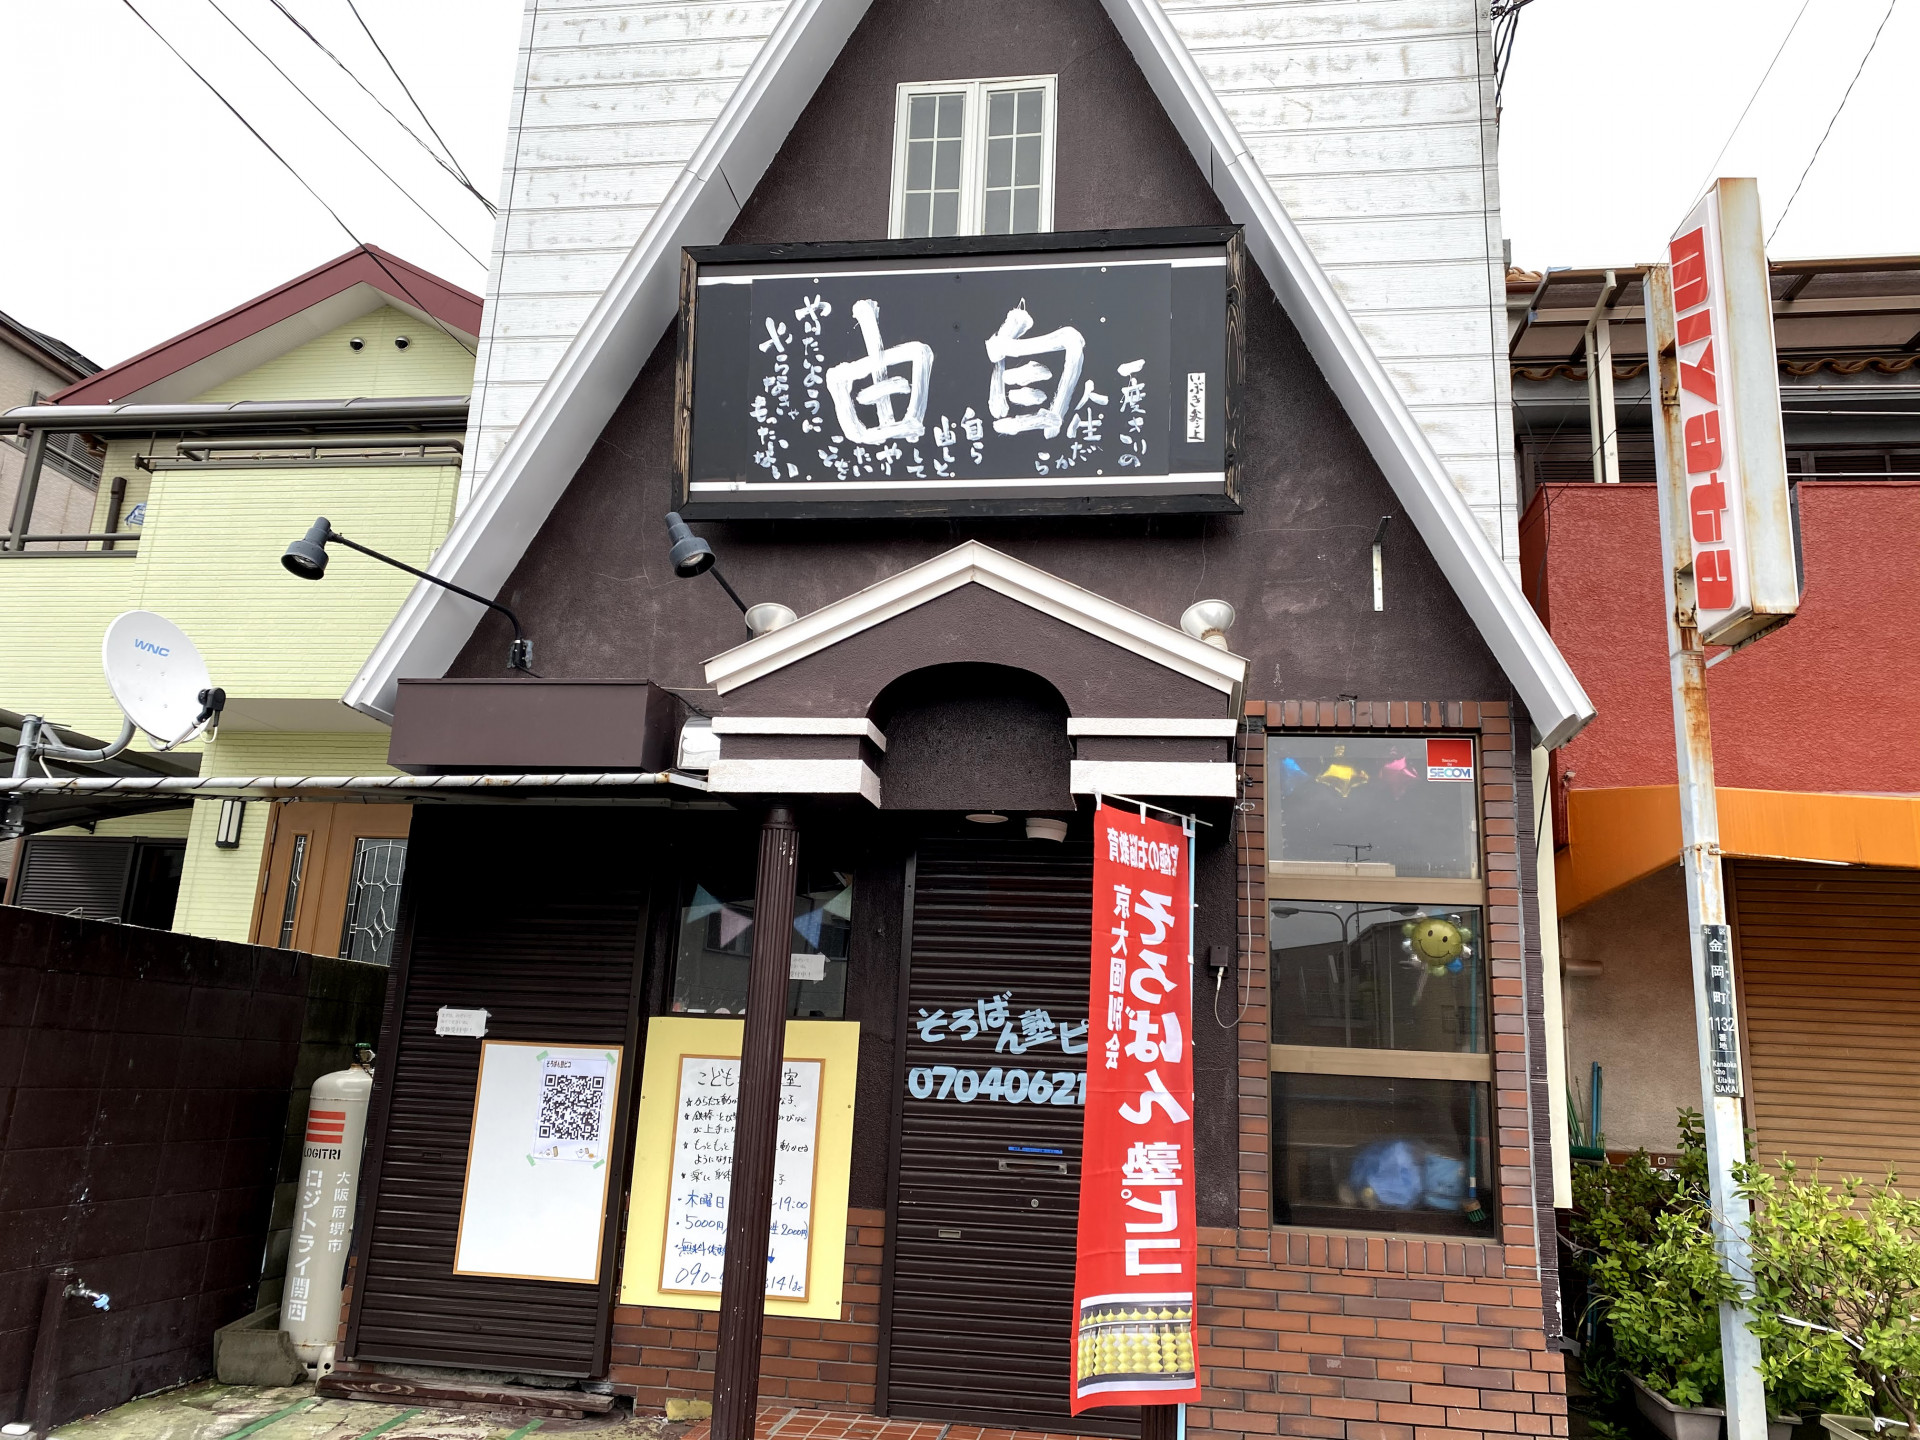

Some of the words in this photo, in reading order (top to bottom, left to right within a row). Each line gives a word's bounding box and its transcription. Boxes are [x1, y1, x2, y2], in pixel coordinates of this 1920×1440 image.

[1117, 358, 1147, 468] 一度きりの
[134, 638, 170, 657] WNC
[1429, 767, 1471, 778] SECOM
[1708, 938, 1727, 1005] 金岡町
[1708, 1016, 1736, 1032] 1132
[1718, 1033, 1728, 1050] 番地
[1712, 1060, 1738, 1069] Kanaoka
[698, 1066, 735, 1087] こども
[1714, 1084, 1739, 1094] SAKAI
[303, 1147, 342, 1160] LOGITRI
[327, 1170, 351, 1254] 大阪府堺市
[287, 1169, 323, 1322] ロジトライ関西
